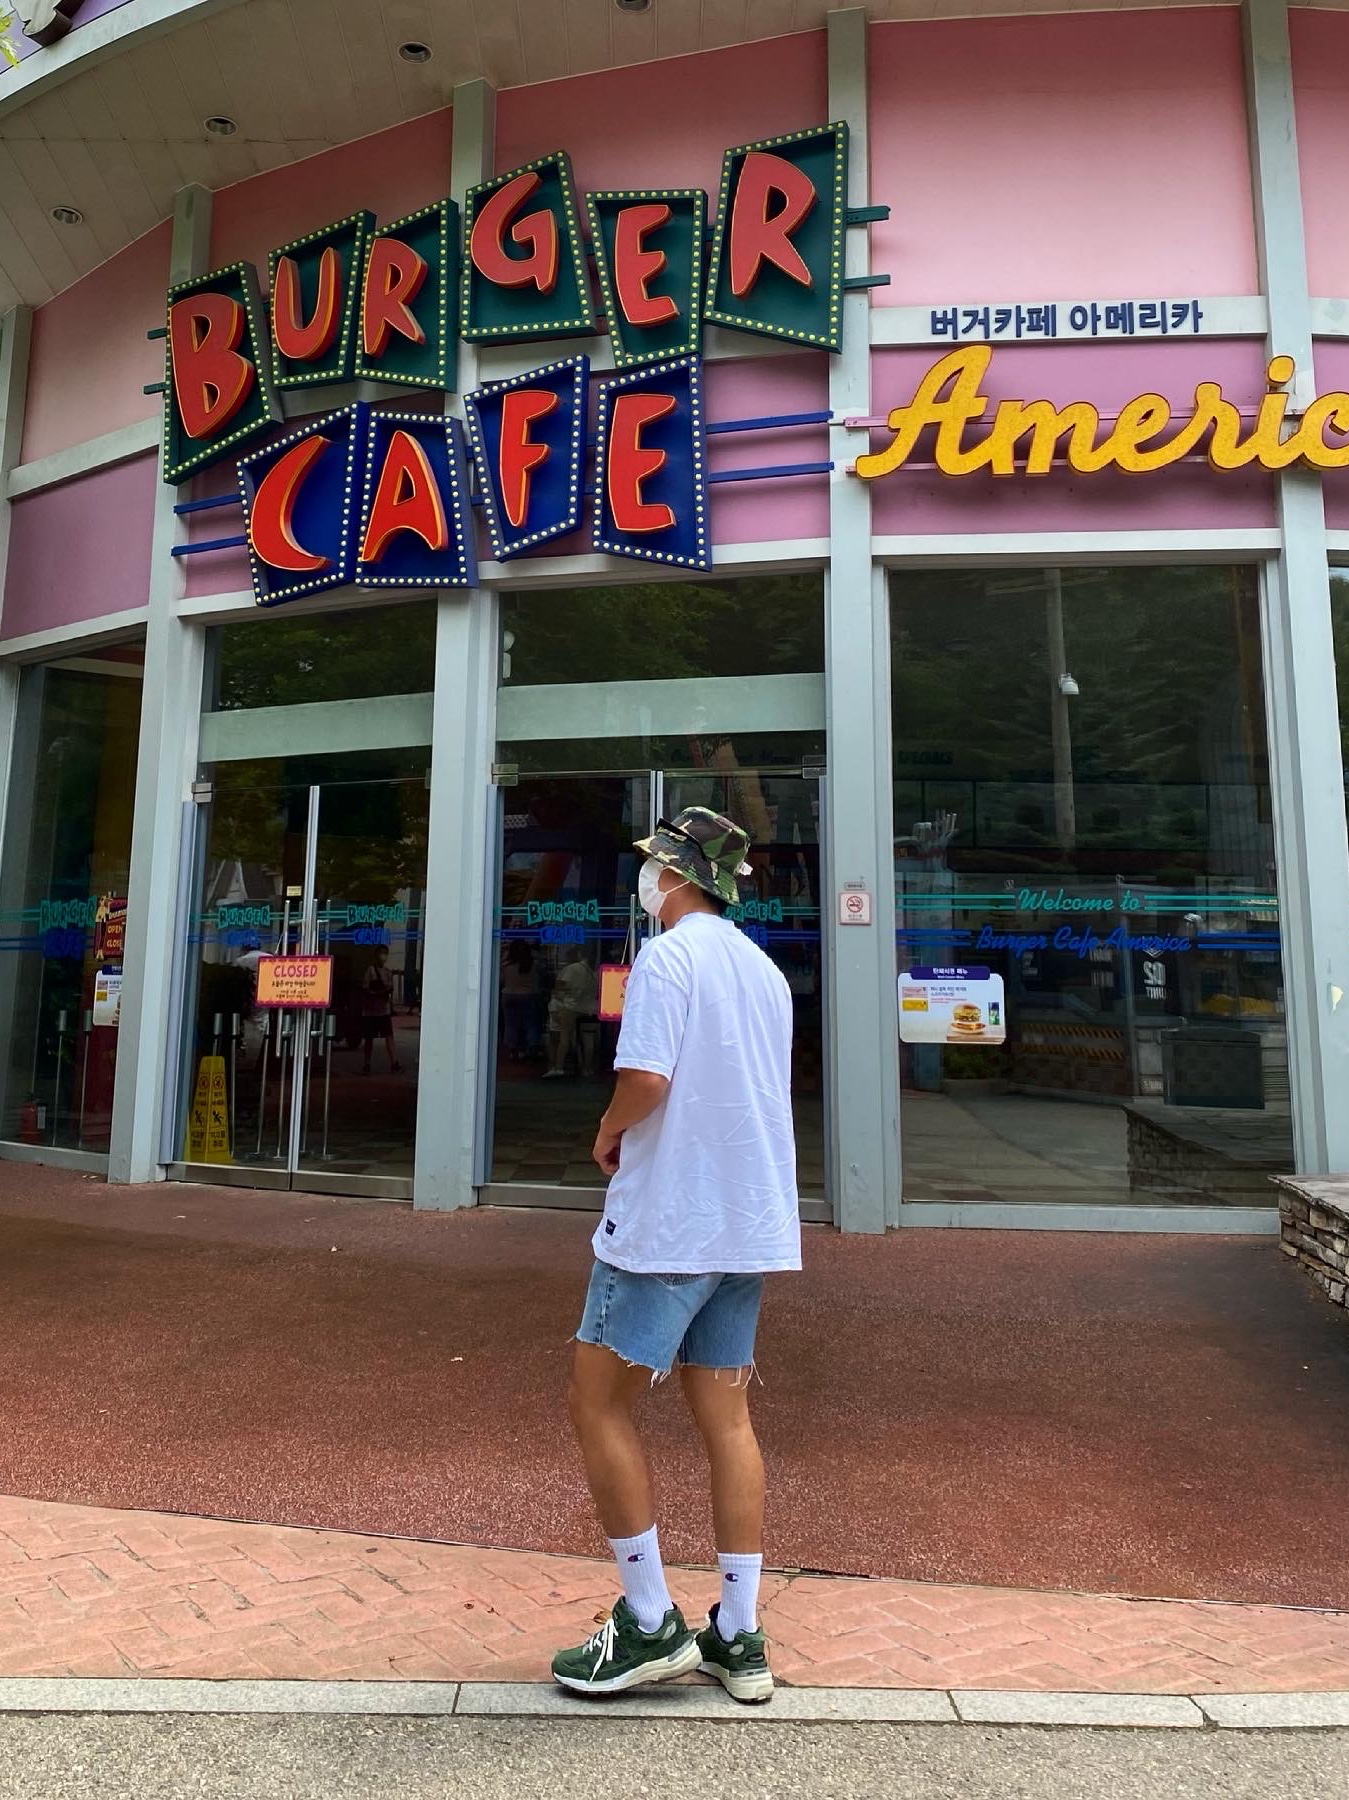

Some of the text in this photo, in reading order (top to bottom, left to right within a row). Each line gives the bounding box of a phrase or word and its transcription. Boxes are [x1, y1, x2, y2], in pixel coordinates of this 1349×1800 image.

[168, 150, 819, 440] BURGER
[931, 299, 1204, 340] 버거카페 아메리카
[249, 389, 677, 571] CAFE
[528, 900, 598, 923] BURGER
[1018, 888, 1141, 911] Welcome to
[218, 905, 270, 928] BURGER
[976, 925, 1048, 959] Burger
[1053, 926, 1099, 958] Cafe
[1104, 926, 1191, 950] America
[273, 964, 318, 978] CLOSED
